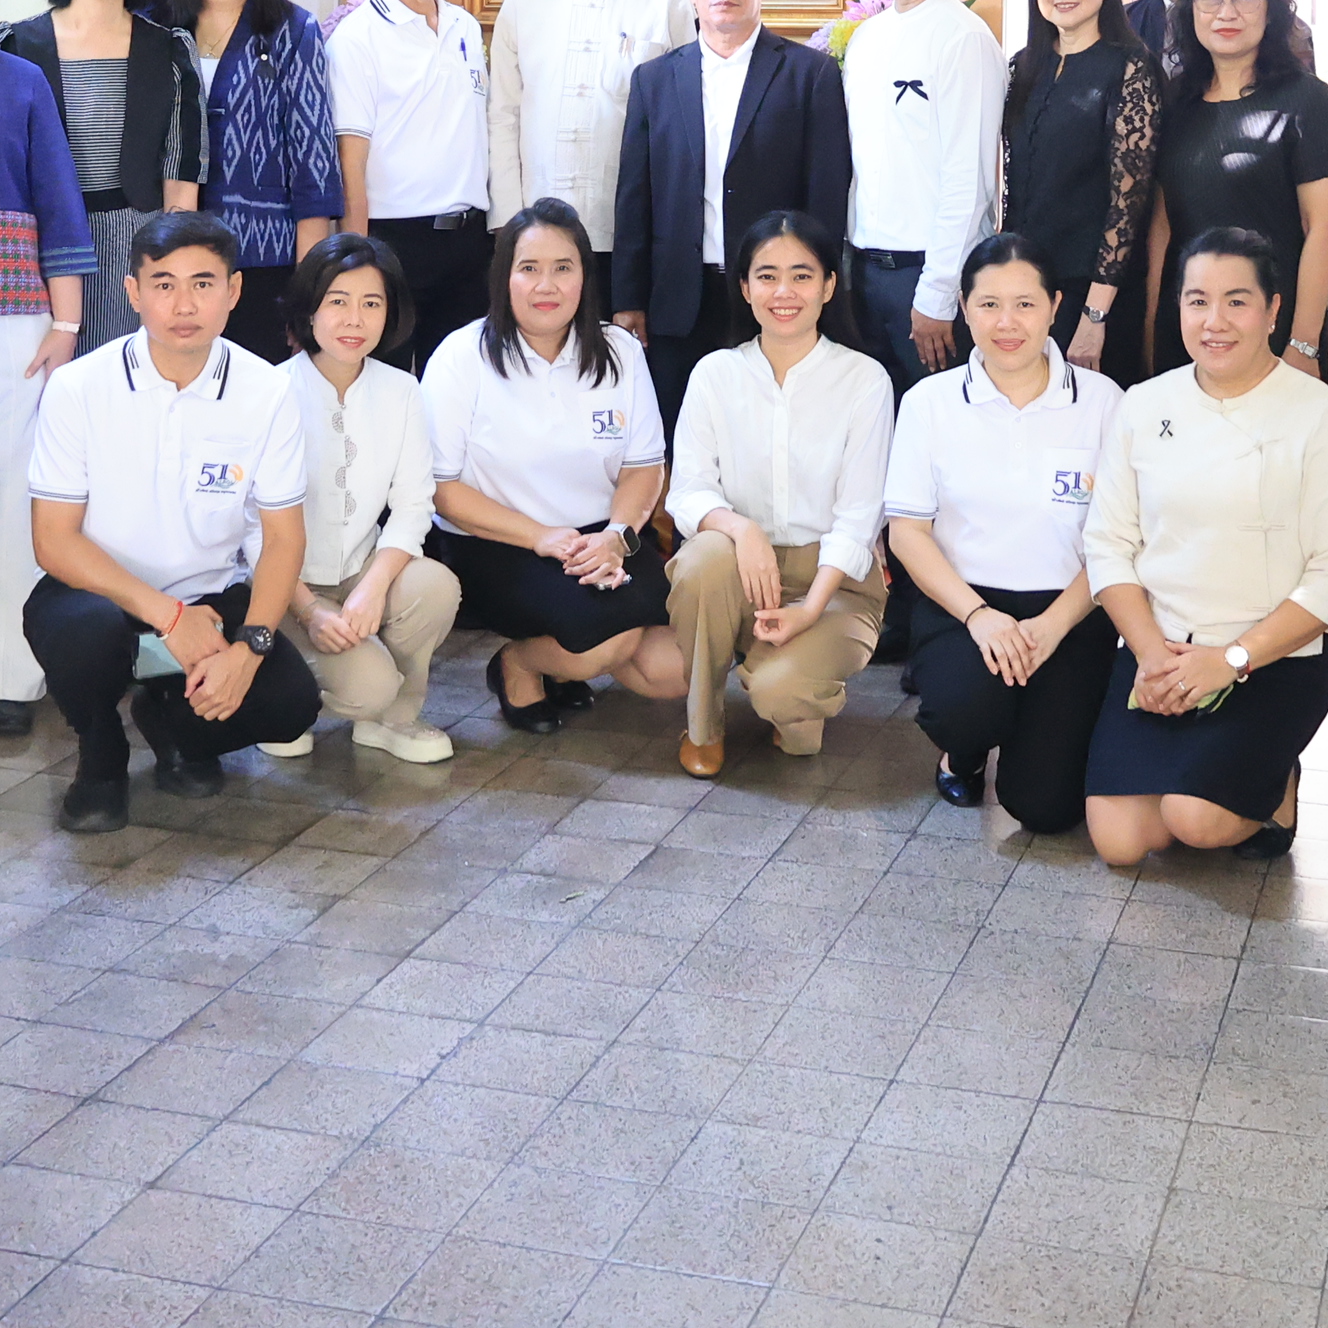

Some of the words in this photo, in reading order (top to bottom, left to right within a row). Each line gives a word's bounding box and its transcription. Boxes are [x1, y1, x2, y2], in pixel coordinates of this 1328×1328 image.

[592, 409, 614, 434] 51
[197, 462, 229, 487] 51
[1052, 470, 1081, 496] 51
